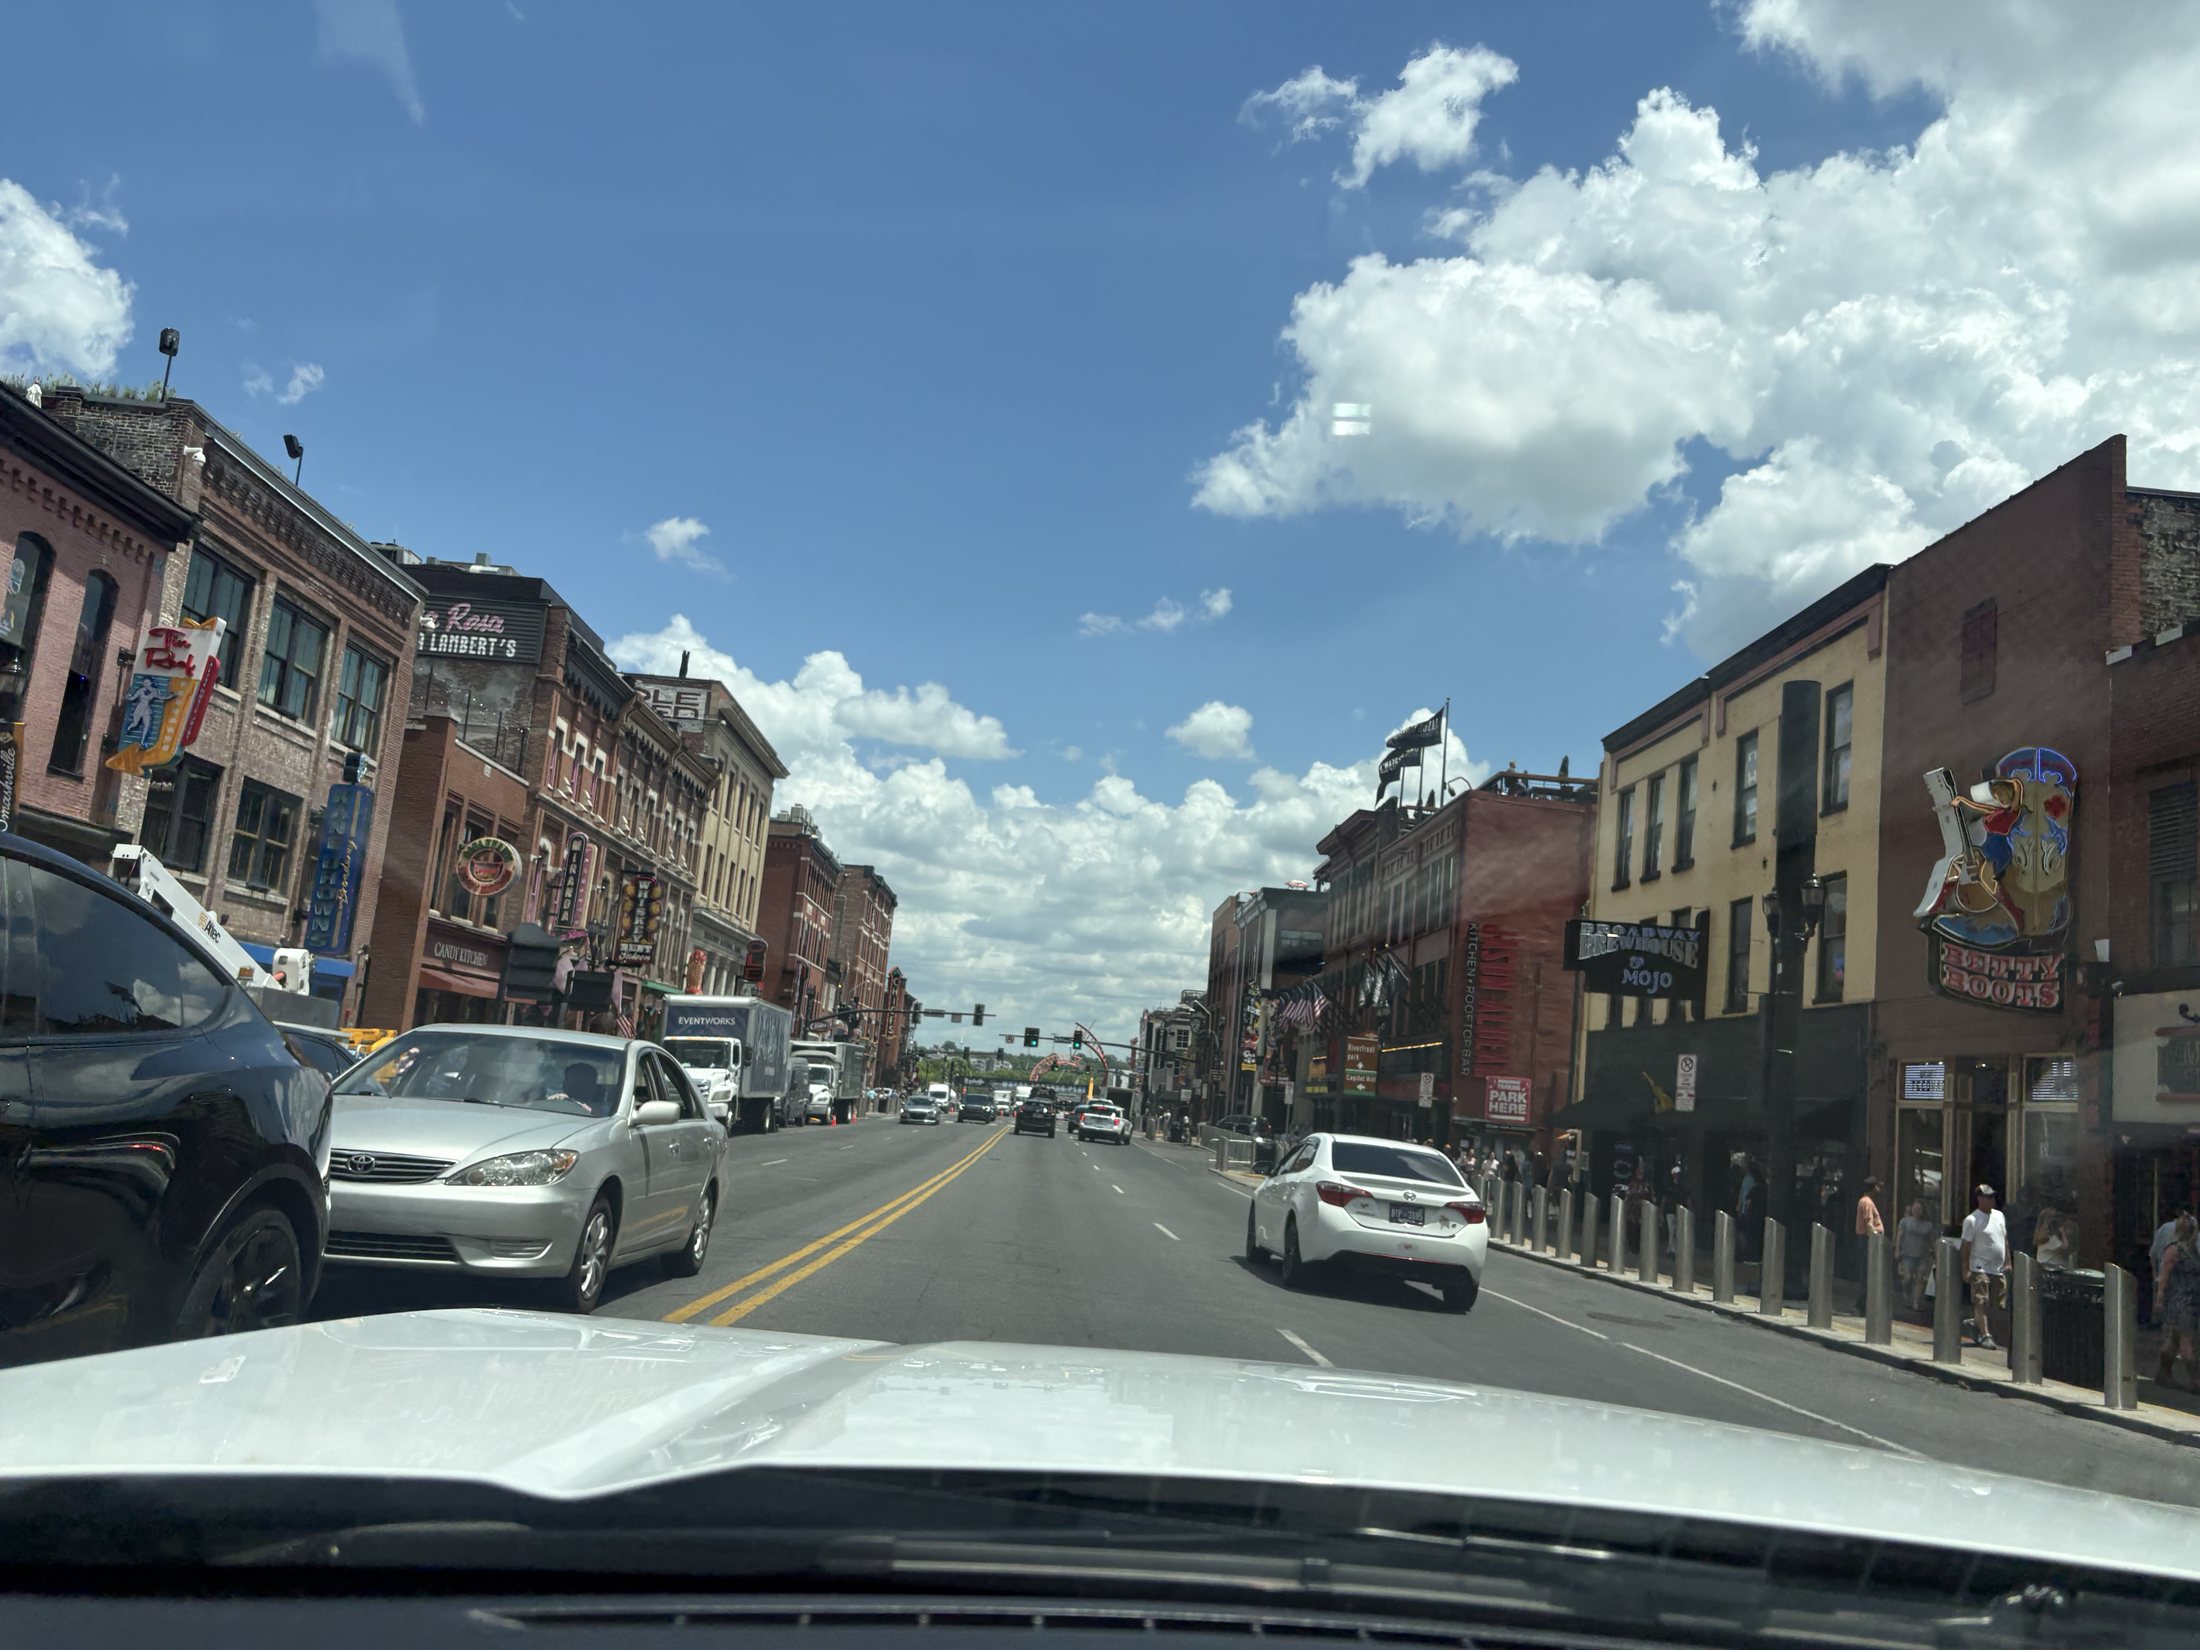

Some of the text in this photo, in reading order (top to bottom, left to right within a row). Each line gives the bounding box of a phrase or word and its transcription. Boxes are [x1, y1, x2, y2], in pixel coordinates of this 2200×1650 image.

[445, 603, 505, 634] Rosa
[429, 632, 517, 657] LAMBERT'S
[561, 840, 582, 921] MIRANDA
[633, 880, 652, 943] WHISKEY
[1580, 922, 1701, 941] BROADWAY
[434, 941, 489, 967] CANDY KITCHEN
[1467, 922, 1479, 977] KITCHEN
[1578, 932, 1699, 969] BREWHOUSE
[1941, 942, 2064, 980] BETTY
[1621, 968, 1673, 994] MOJO
[1942, 963, 2061, 1008] BOOTS
[678, 1016, 736, 1026] EVENTWORKS
[1488, 1101, 1528, 1115] HERE
[1489, 1090, 1527, 1103] PARK
